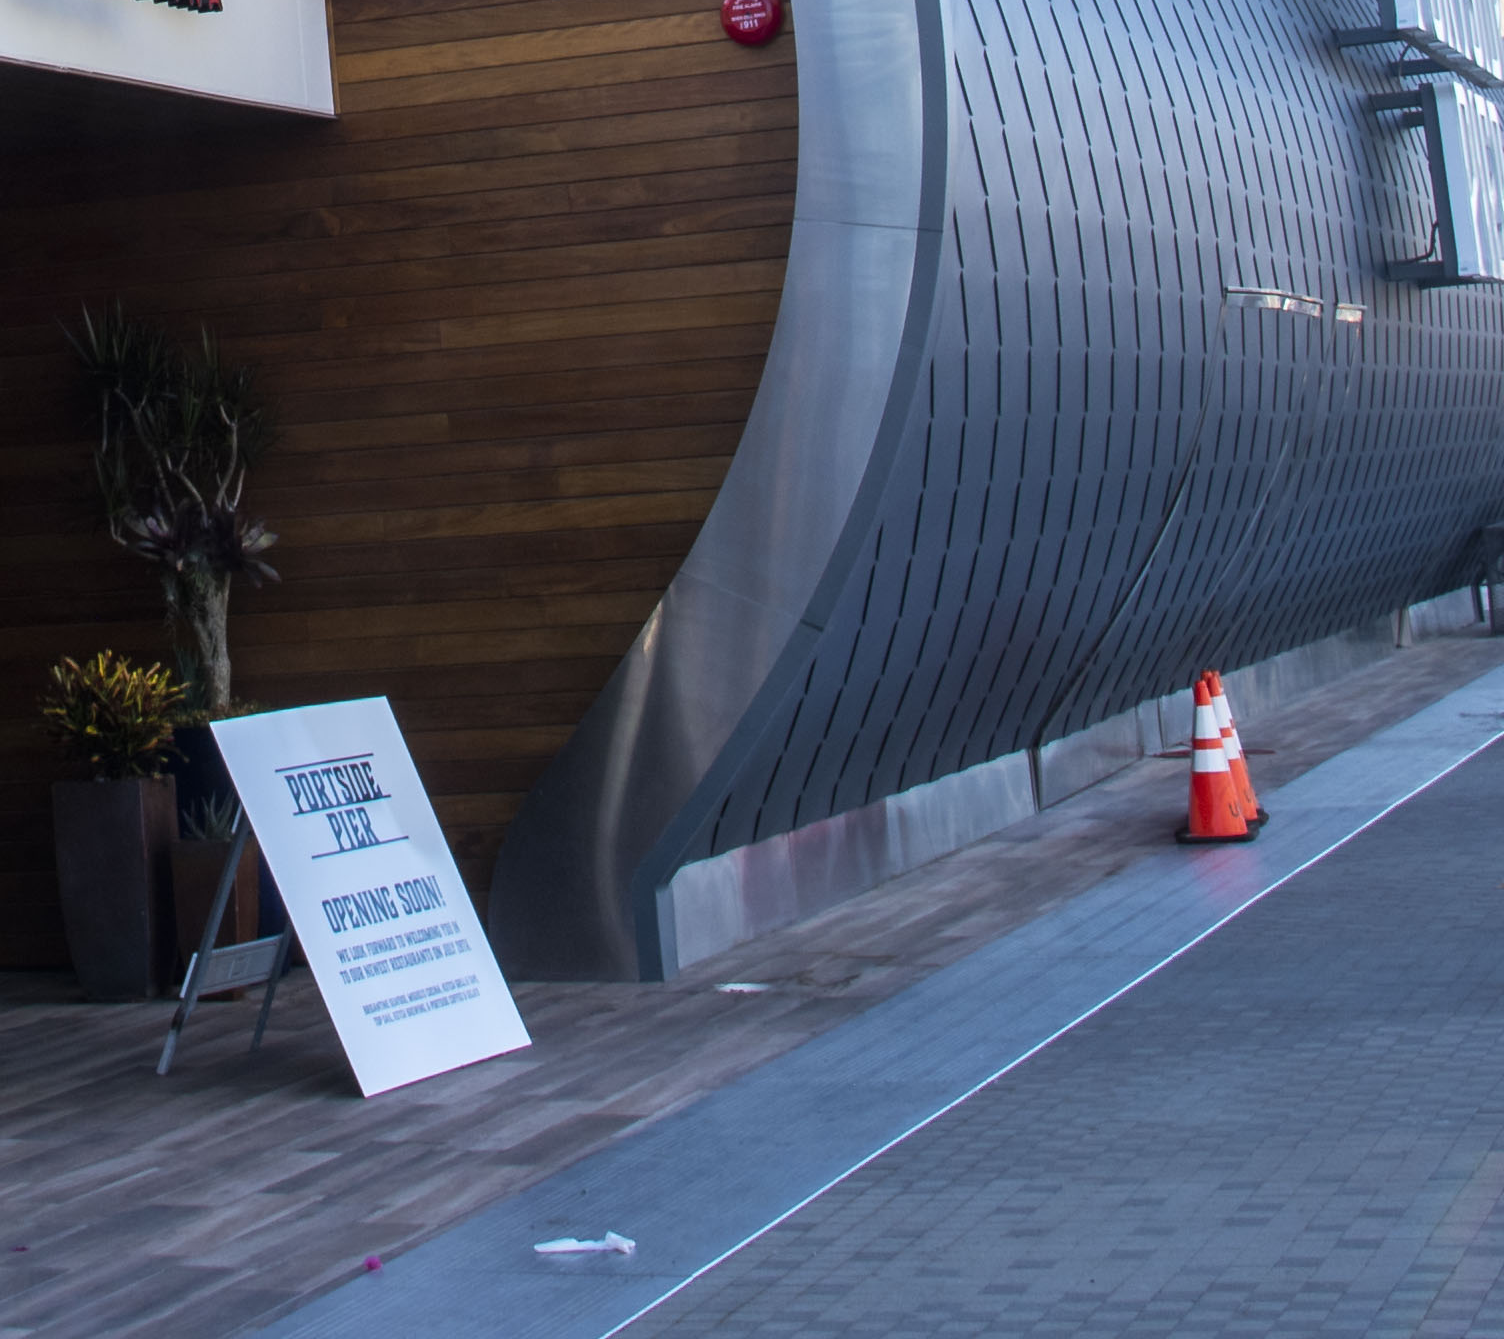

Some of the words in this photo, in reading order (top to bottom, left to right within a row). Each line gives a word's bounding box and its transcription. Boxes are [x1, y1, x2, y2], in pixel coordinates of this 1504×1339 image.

[284, 761, 384, 814] PORTSIDE
[326, 806, 381, 852] PIER
[322, 886, 399, 933] OPENING
[394, 875, 447, 915] SOON!
